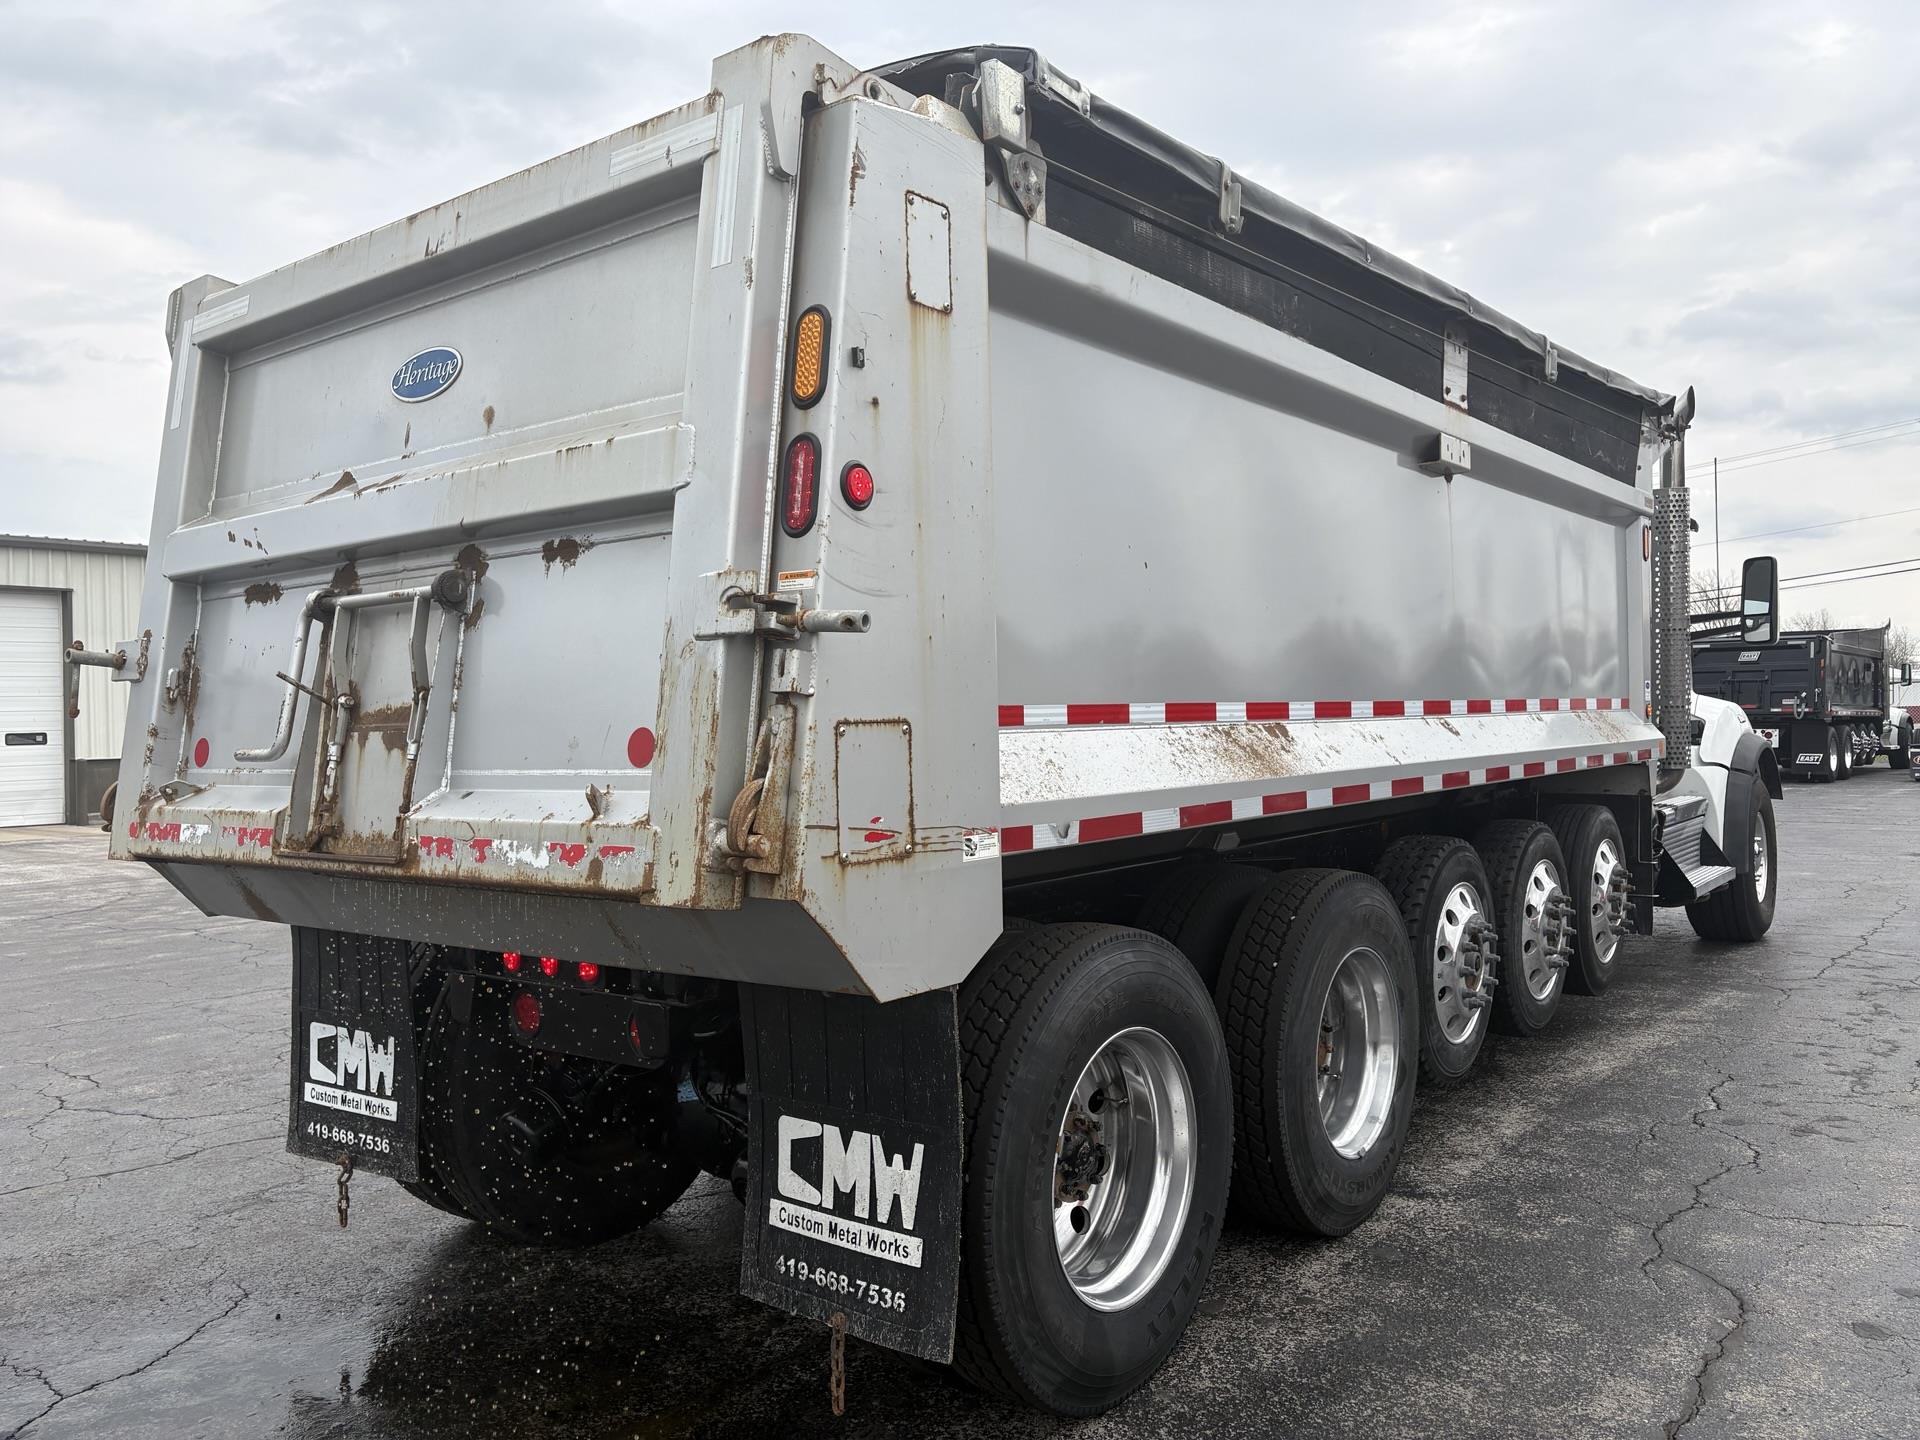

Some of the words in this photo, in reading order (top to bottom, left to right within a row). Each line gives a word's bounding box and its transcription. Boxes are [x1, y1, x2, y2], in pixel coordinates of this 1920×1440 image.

[393, 358, 457, 389] Heritage
[309, 1021, 395, 1096] CMW
[310, 1087, 339, 1105] Custom
[340, 1094, 362, 1111] Metal
[364, 1100, 391, 1117] Works
[307, 1122, 390, 1154] 419-668-7536
[778, 1114, 925, 1231] CMW
[779, 1207, 823, 1236] Custom
[828, 1221, 861, 1247] Metal
[867, 1231, 910, 1260] Works
[775, 1255, 906, 1313] 419-668-7536
